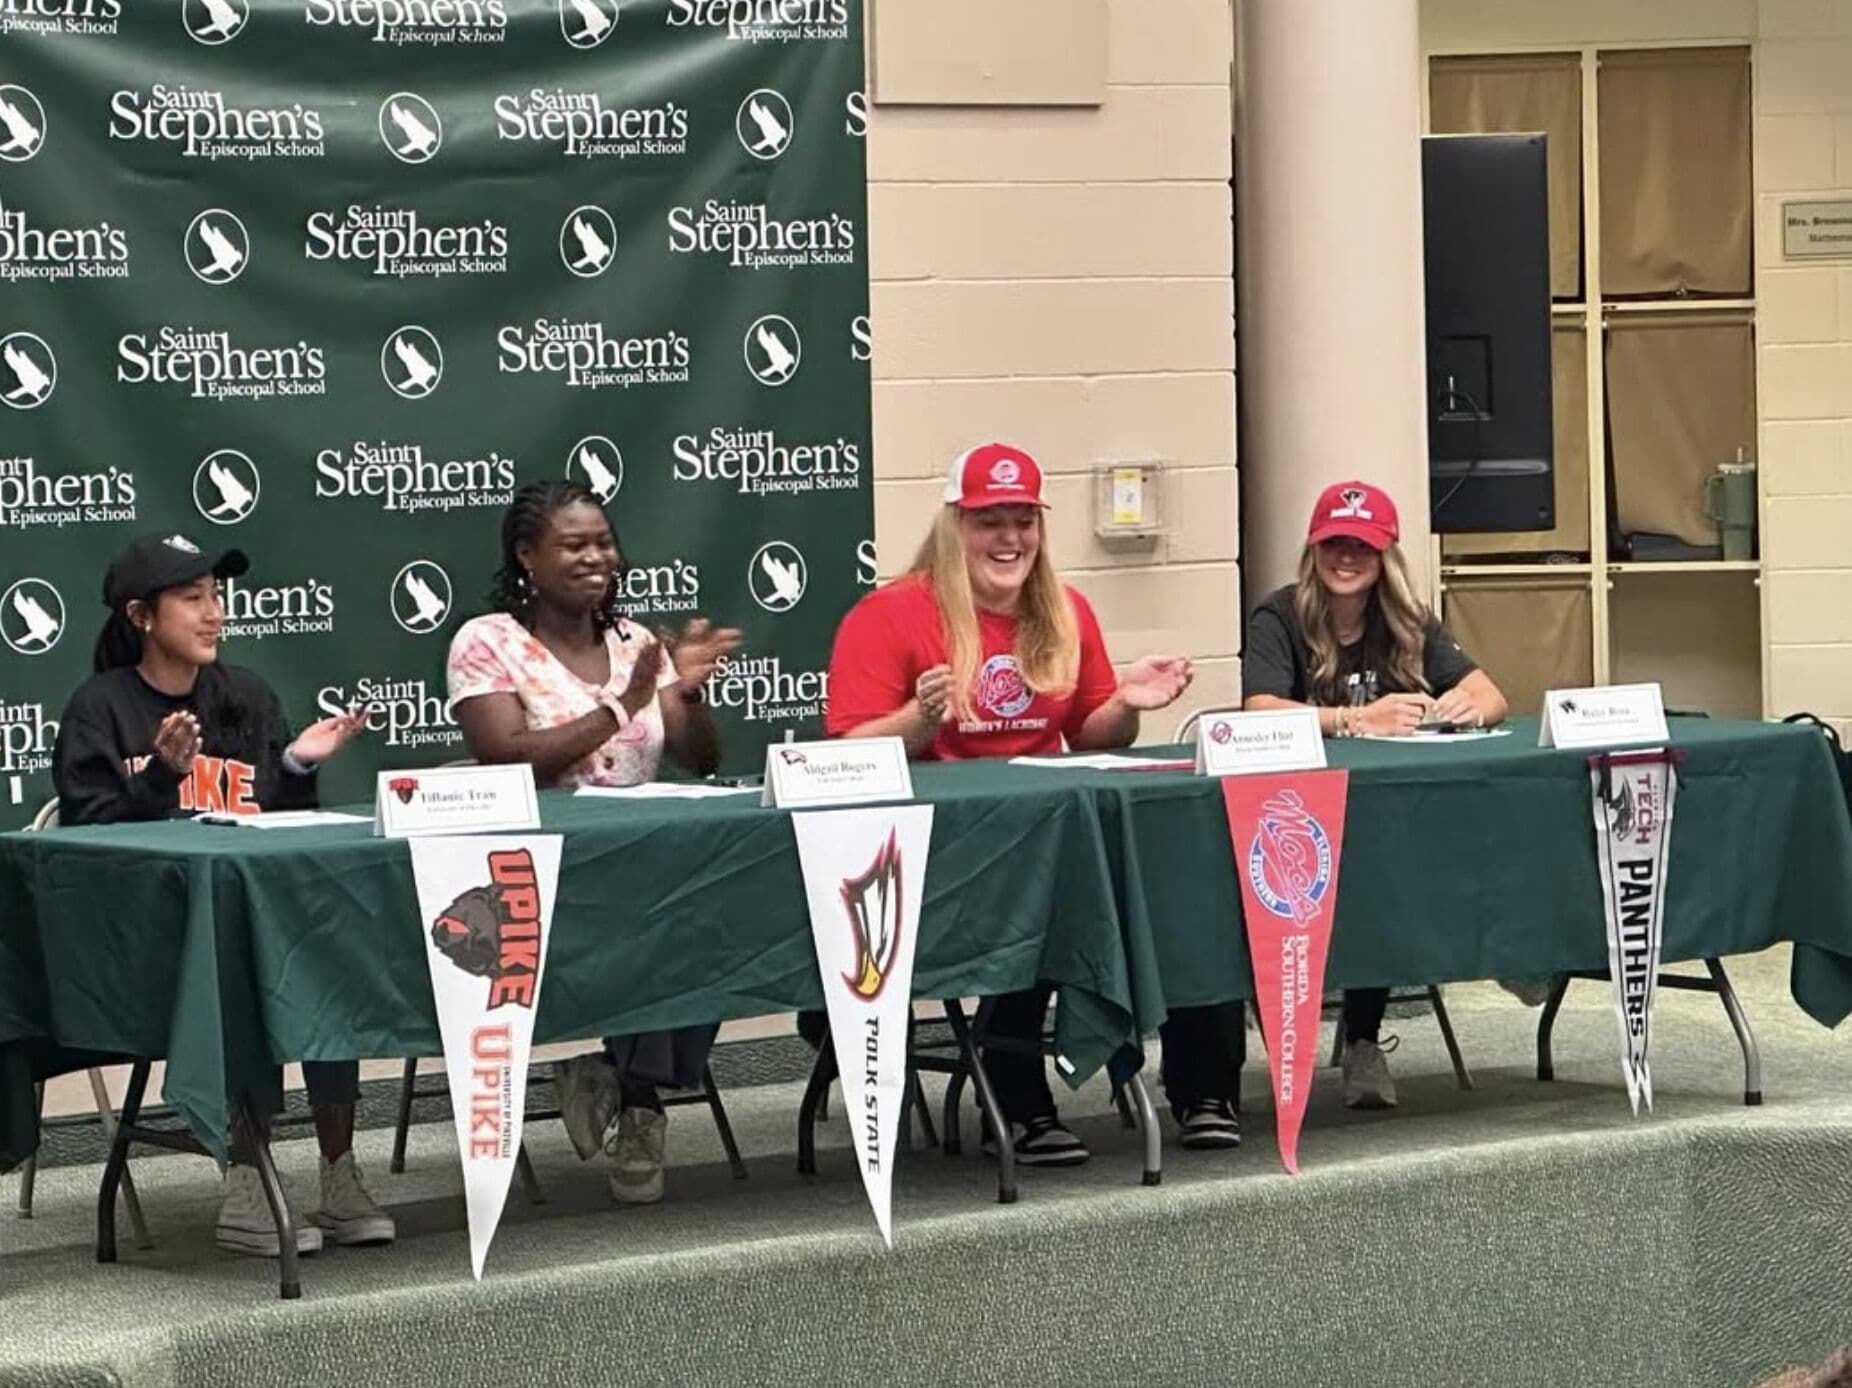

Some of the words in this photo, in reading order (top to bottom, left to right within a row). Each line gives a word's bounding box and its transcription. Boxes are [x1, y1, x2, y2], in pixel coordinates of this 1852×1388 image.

[0, 15, 61, 36] piscopal
[65, 17, 118, 34] School
[389, 27, 455, 46] Episcopal
[458, 27, 506, 43] School
[740, 25, 801, 44] Episcopal
[803, 25, 848, 40] School
[152, 84, 215, 109] Saint
[530, 88, 590, 112] Saint
[110, 90, 324, 156] Stephen's
[494, 92, 688, 155] Stephen's
[200, 141, 272, 161] Episcopal
[274, 141, 325, 157] School
[579, 141, 640, 159] Episcopal
[642, 140, 686, 154] School
[347, 204, 407, 229] Saint
[704, 200, 758, 222] Saint
[0, 206, 128, 261] hen's
[306, 210, 508, 275] Stephen's
[668, 204, 854, 266] Stephen's
[0, 261, 74, 283] Episcopal
[78, 261, 129, 278] School
[390, 258, 456, 278] Episcopal
[459, 257, 507, 273] School
[745, 252, 808, 270] Episcopal
[810, 251, 853, 265] School
[159, 327, 220, 351] Saint
[535, 318, 593, 341] Saint
[117, 331, 326, 398] Stephen's
[497, 322, 689, 386] Stephen's
[207, 380, 274, 401] Episcopal
[277, 380, 326, 396] School
[582, 370, 643, 389] Episcopal
[645, 368, 689, 383] School
[710, 427, 766, 450] Saint
[354, 441, 412, 465] Saint
[672, 431, 860, 493] Stephen's
[316, 445, 515, 510] Stephen's
[752, 477, 813, 496] Episcopal
[816, 475, 859, 489] School
[0, 457, 136, 525] phen's
[400, 493, 465, 513] Episcopal
[468, 490, 514, 507] School
[10, 507, 80, 530] Episcopal
[84, 505, 136, 521] School
[217, 577, 334, 620] hen's
[652, 596, 698, 612] School
[217, 619, 279, 642] piscopal
[282, 617, 333, 633] School
[715, 653, 772, 677] Saint
[357, 676, 417, 700] Saint
[0, 699, 34, 723] int
[317, 680, 459, 745] Steph
[758, 702, 819, 723] Episcopal
[402, 729, 463, 748] Episcopa
[178, 754, 260, 815] IKE
[1636, 773, 1652, 844] TECH
[486, 848, 541, 1011] UPIKE
[1617, 858, 1653, 1038] PANTHERS
[865, 1016, 880, 1086] POLK
[469, 1022, 512, 1161] UPIKE
[864, 1095, 881, 1174] STATE
